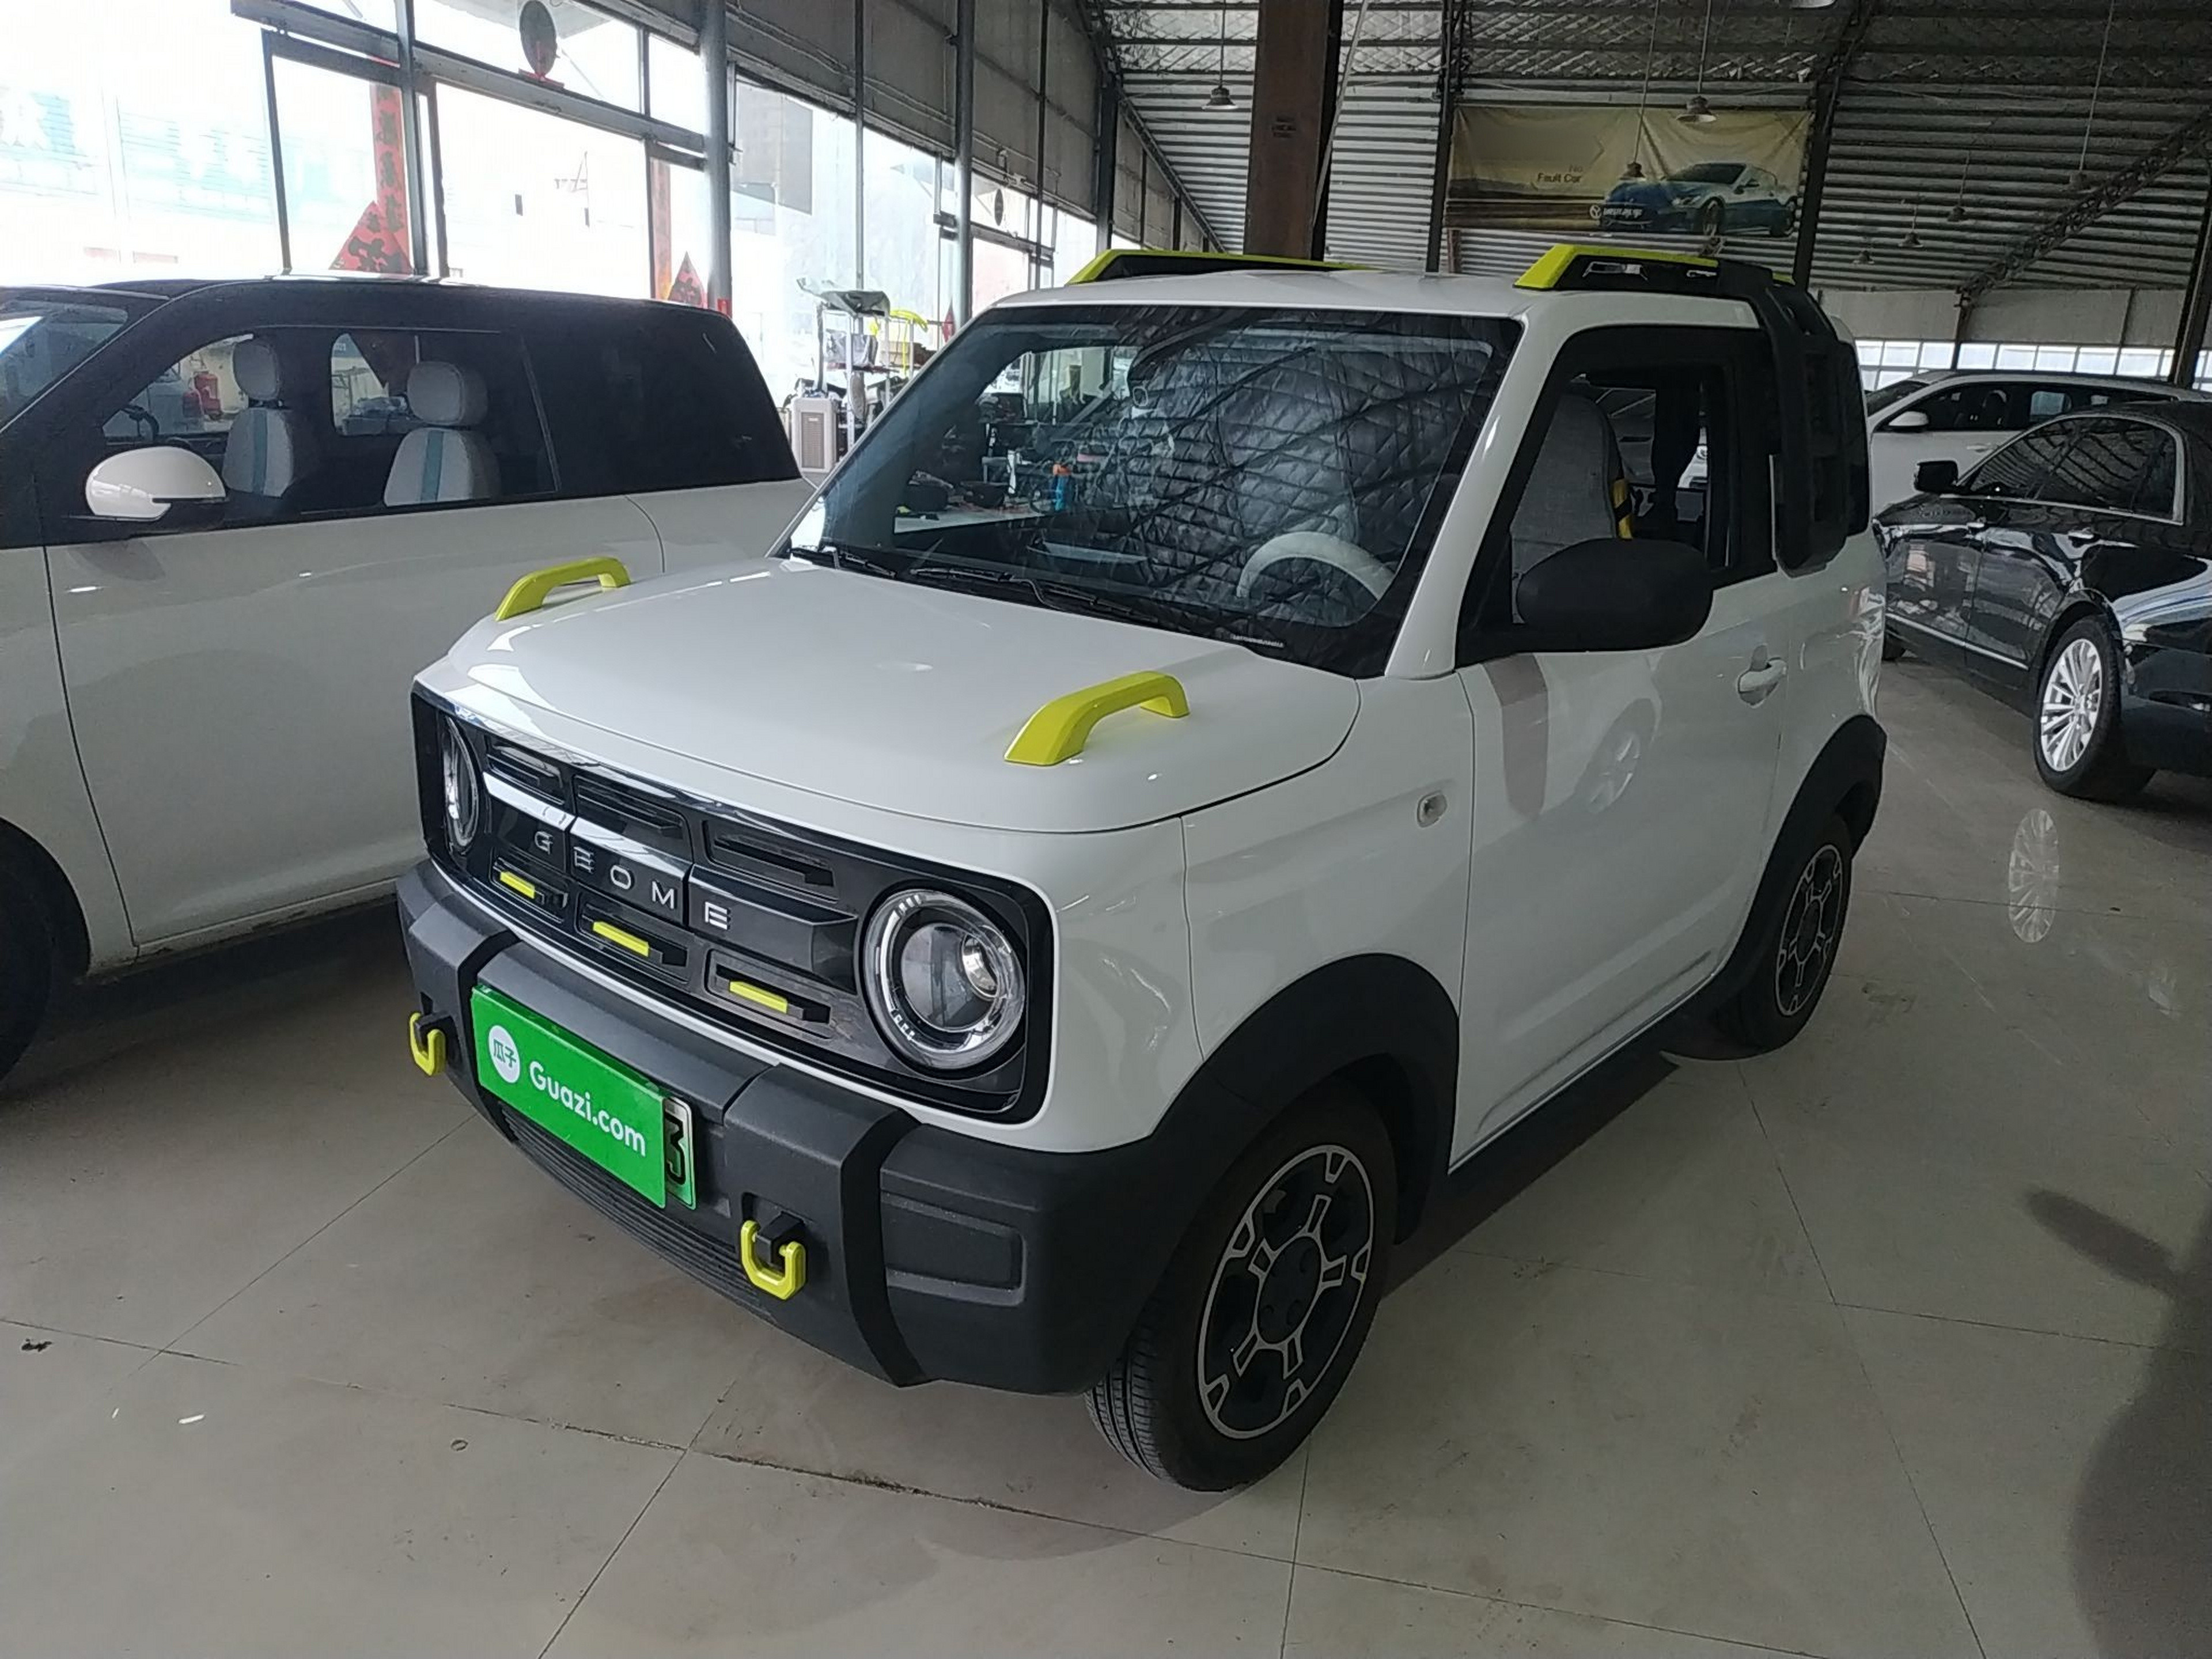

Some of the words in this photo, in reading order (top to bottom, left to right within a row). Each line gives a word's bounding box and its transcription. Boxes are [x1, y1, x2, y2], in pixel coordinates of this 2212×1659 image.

[1537, 173, 1562, 183] Fault
[1564, 173, 1581, 183] Car
[534, 831, 731, 930] GEOME
[493, 1039, 517, 1068] 瓜子
[529, 1060, 646, 1157] Guazi.com
